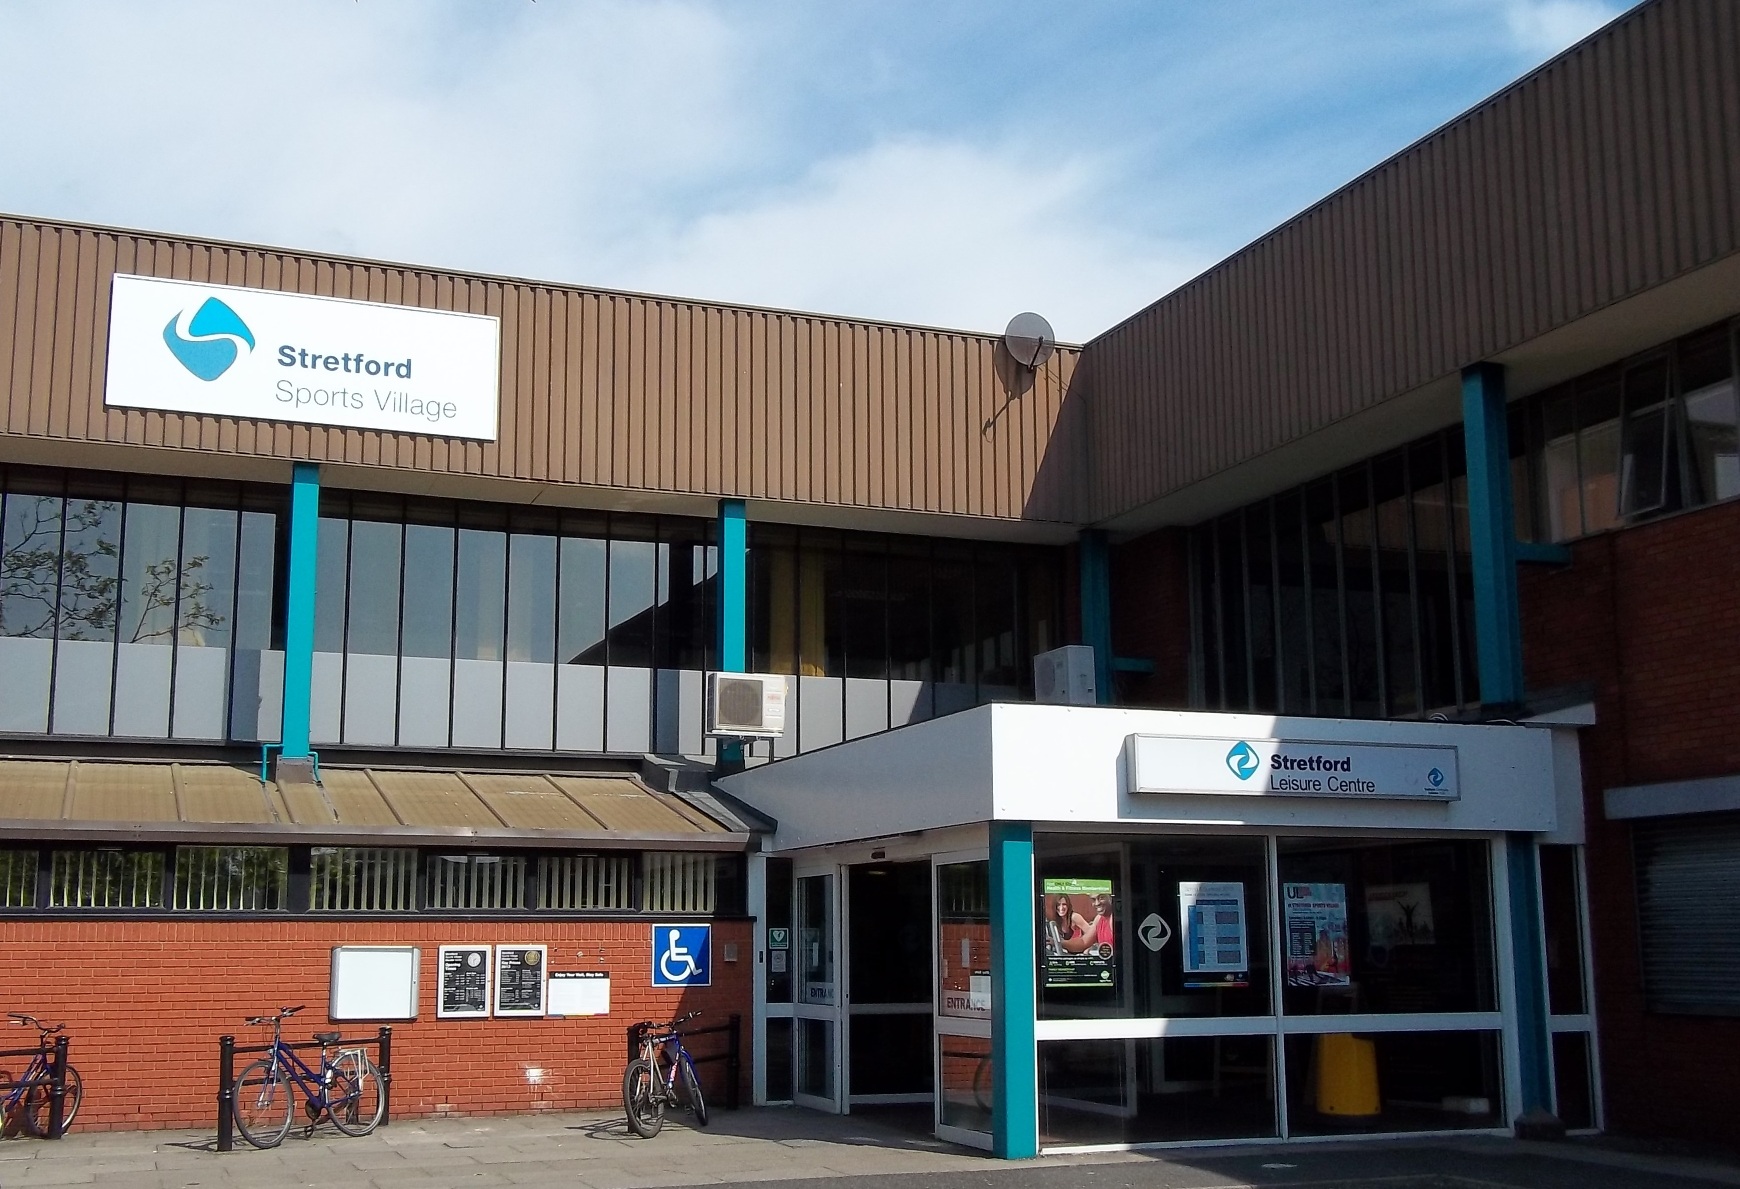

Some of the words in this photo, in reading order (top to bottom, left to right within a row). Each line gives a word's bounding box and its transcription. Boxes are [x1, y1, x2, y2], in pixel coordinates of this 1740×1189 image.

[277, 344, 412, 379] Stretford
[275, 379, 364, 410] Sports
[374, 389, 458, 422] Village
[1270, 754, 1351, 773] Stretford
[1270, 774, 1322, 792] Leisure
[1327, 775, 1376, 793] Centre
